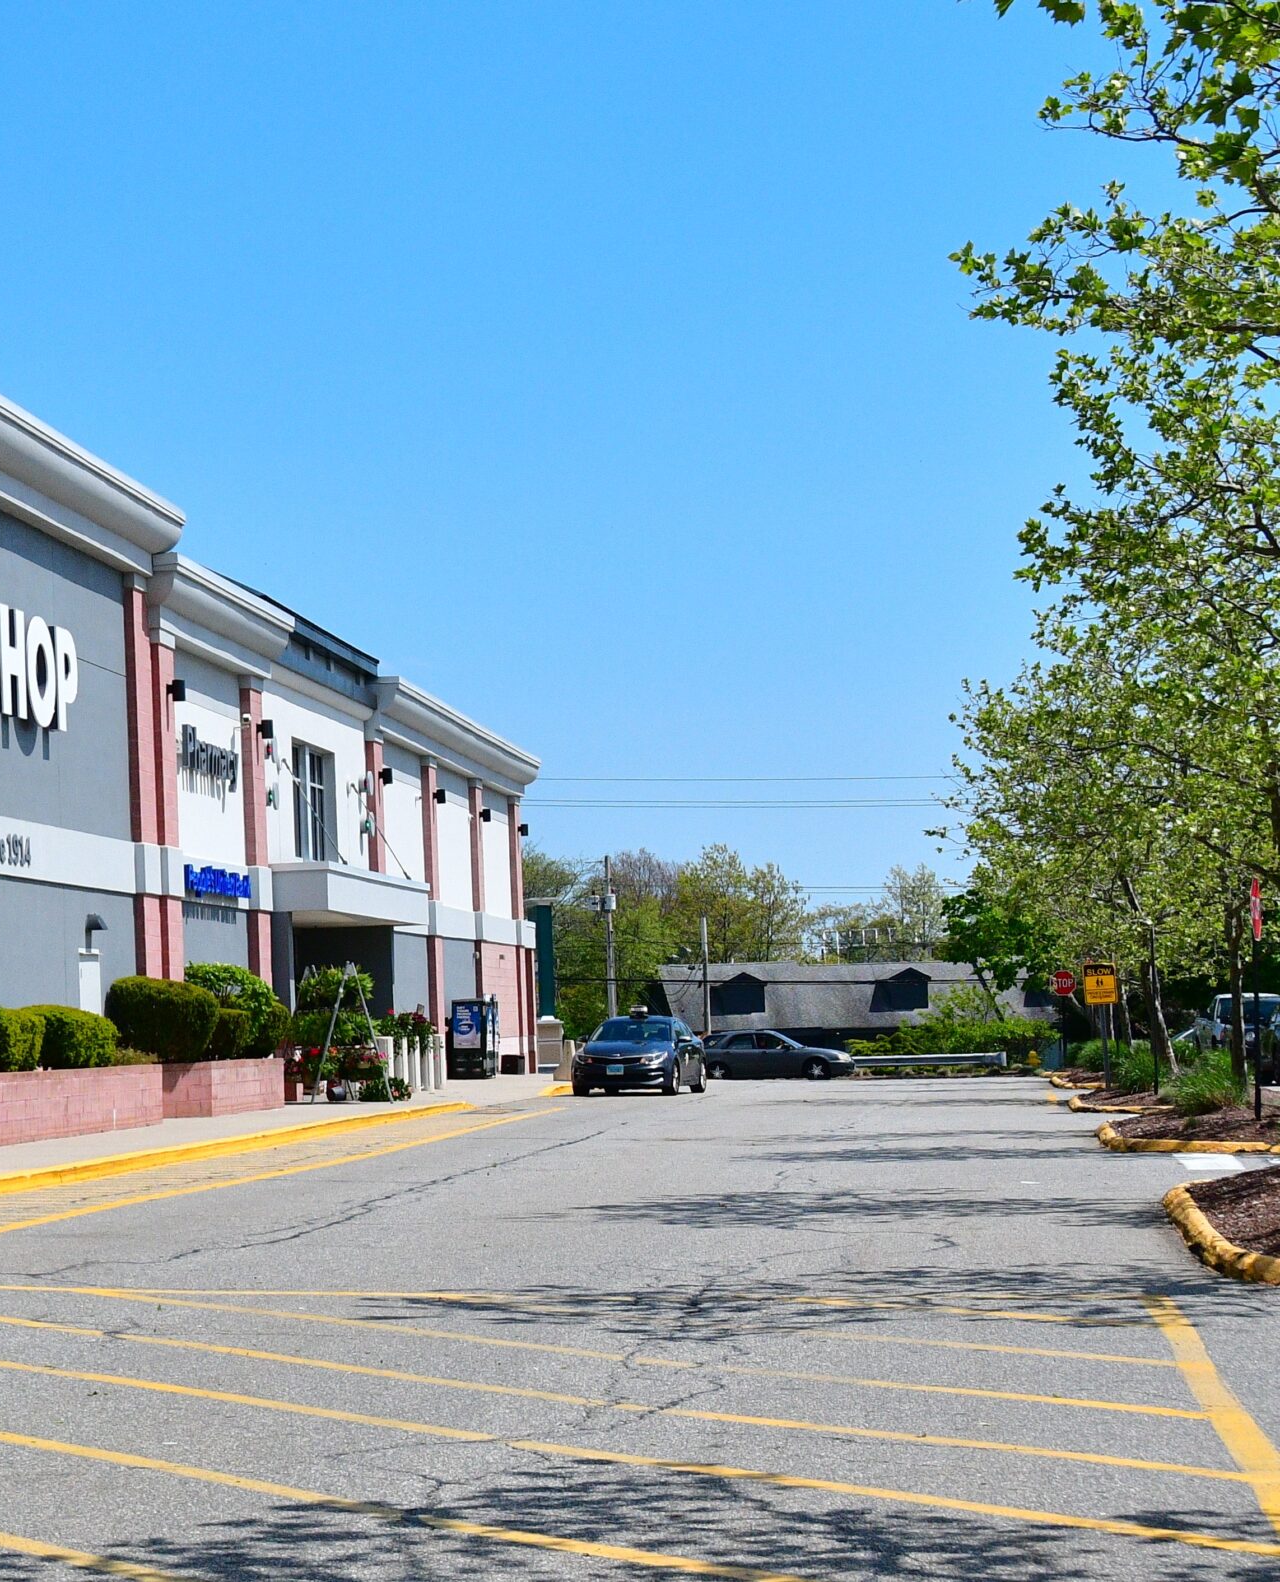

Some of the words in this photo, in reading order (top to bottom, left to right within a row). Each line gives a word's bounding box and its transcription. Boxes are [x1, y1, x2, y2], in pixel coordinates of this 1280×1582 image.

[182, 724, 239, 793] Pharmacy
[6, 832, 32, 868] 1914
[1052, 978, 1074, 988] STOP
[1086, 968, 1112, 976] SLOW
